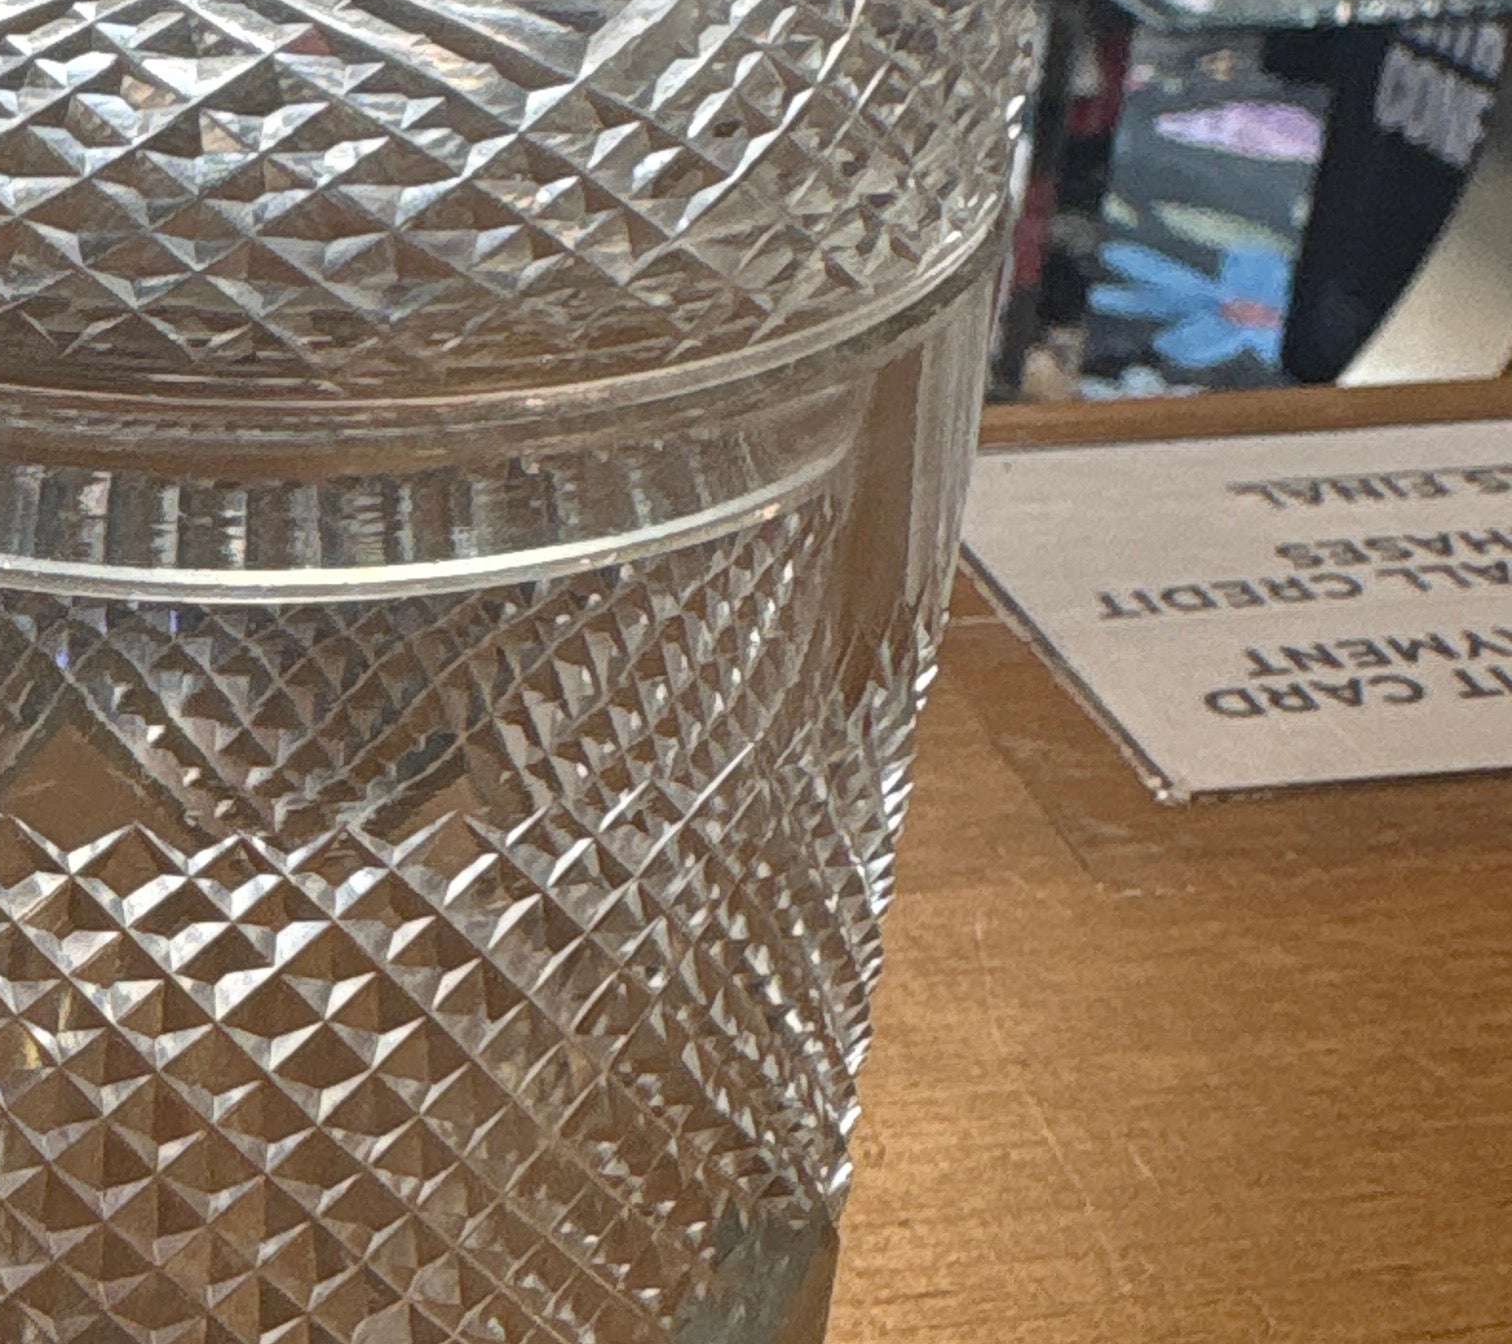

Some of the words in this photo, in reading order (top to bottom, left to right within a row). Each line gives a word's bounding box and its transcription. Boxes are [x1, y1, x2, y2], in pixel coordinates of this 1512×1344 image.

[1228, 471, 1450, 509] FINAL
[1099, 572, 1363, 620] CREDIT
[1377, 560, 1510, 592] ALL
[1203, 674, 1426, 719] CARD
